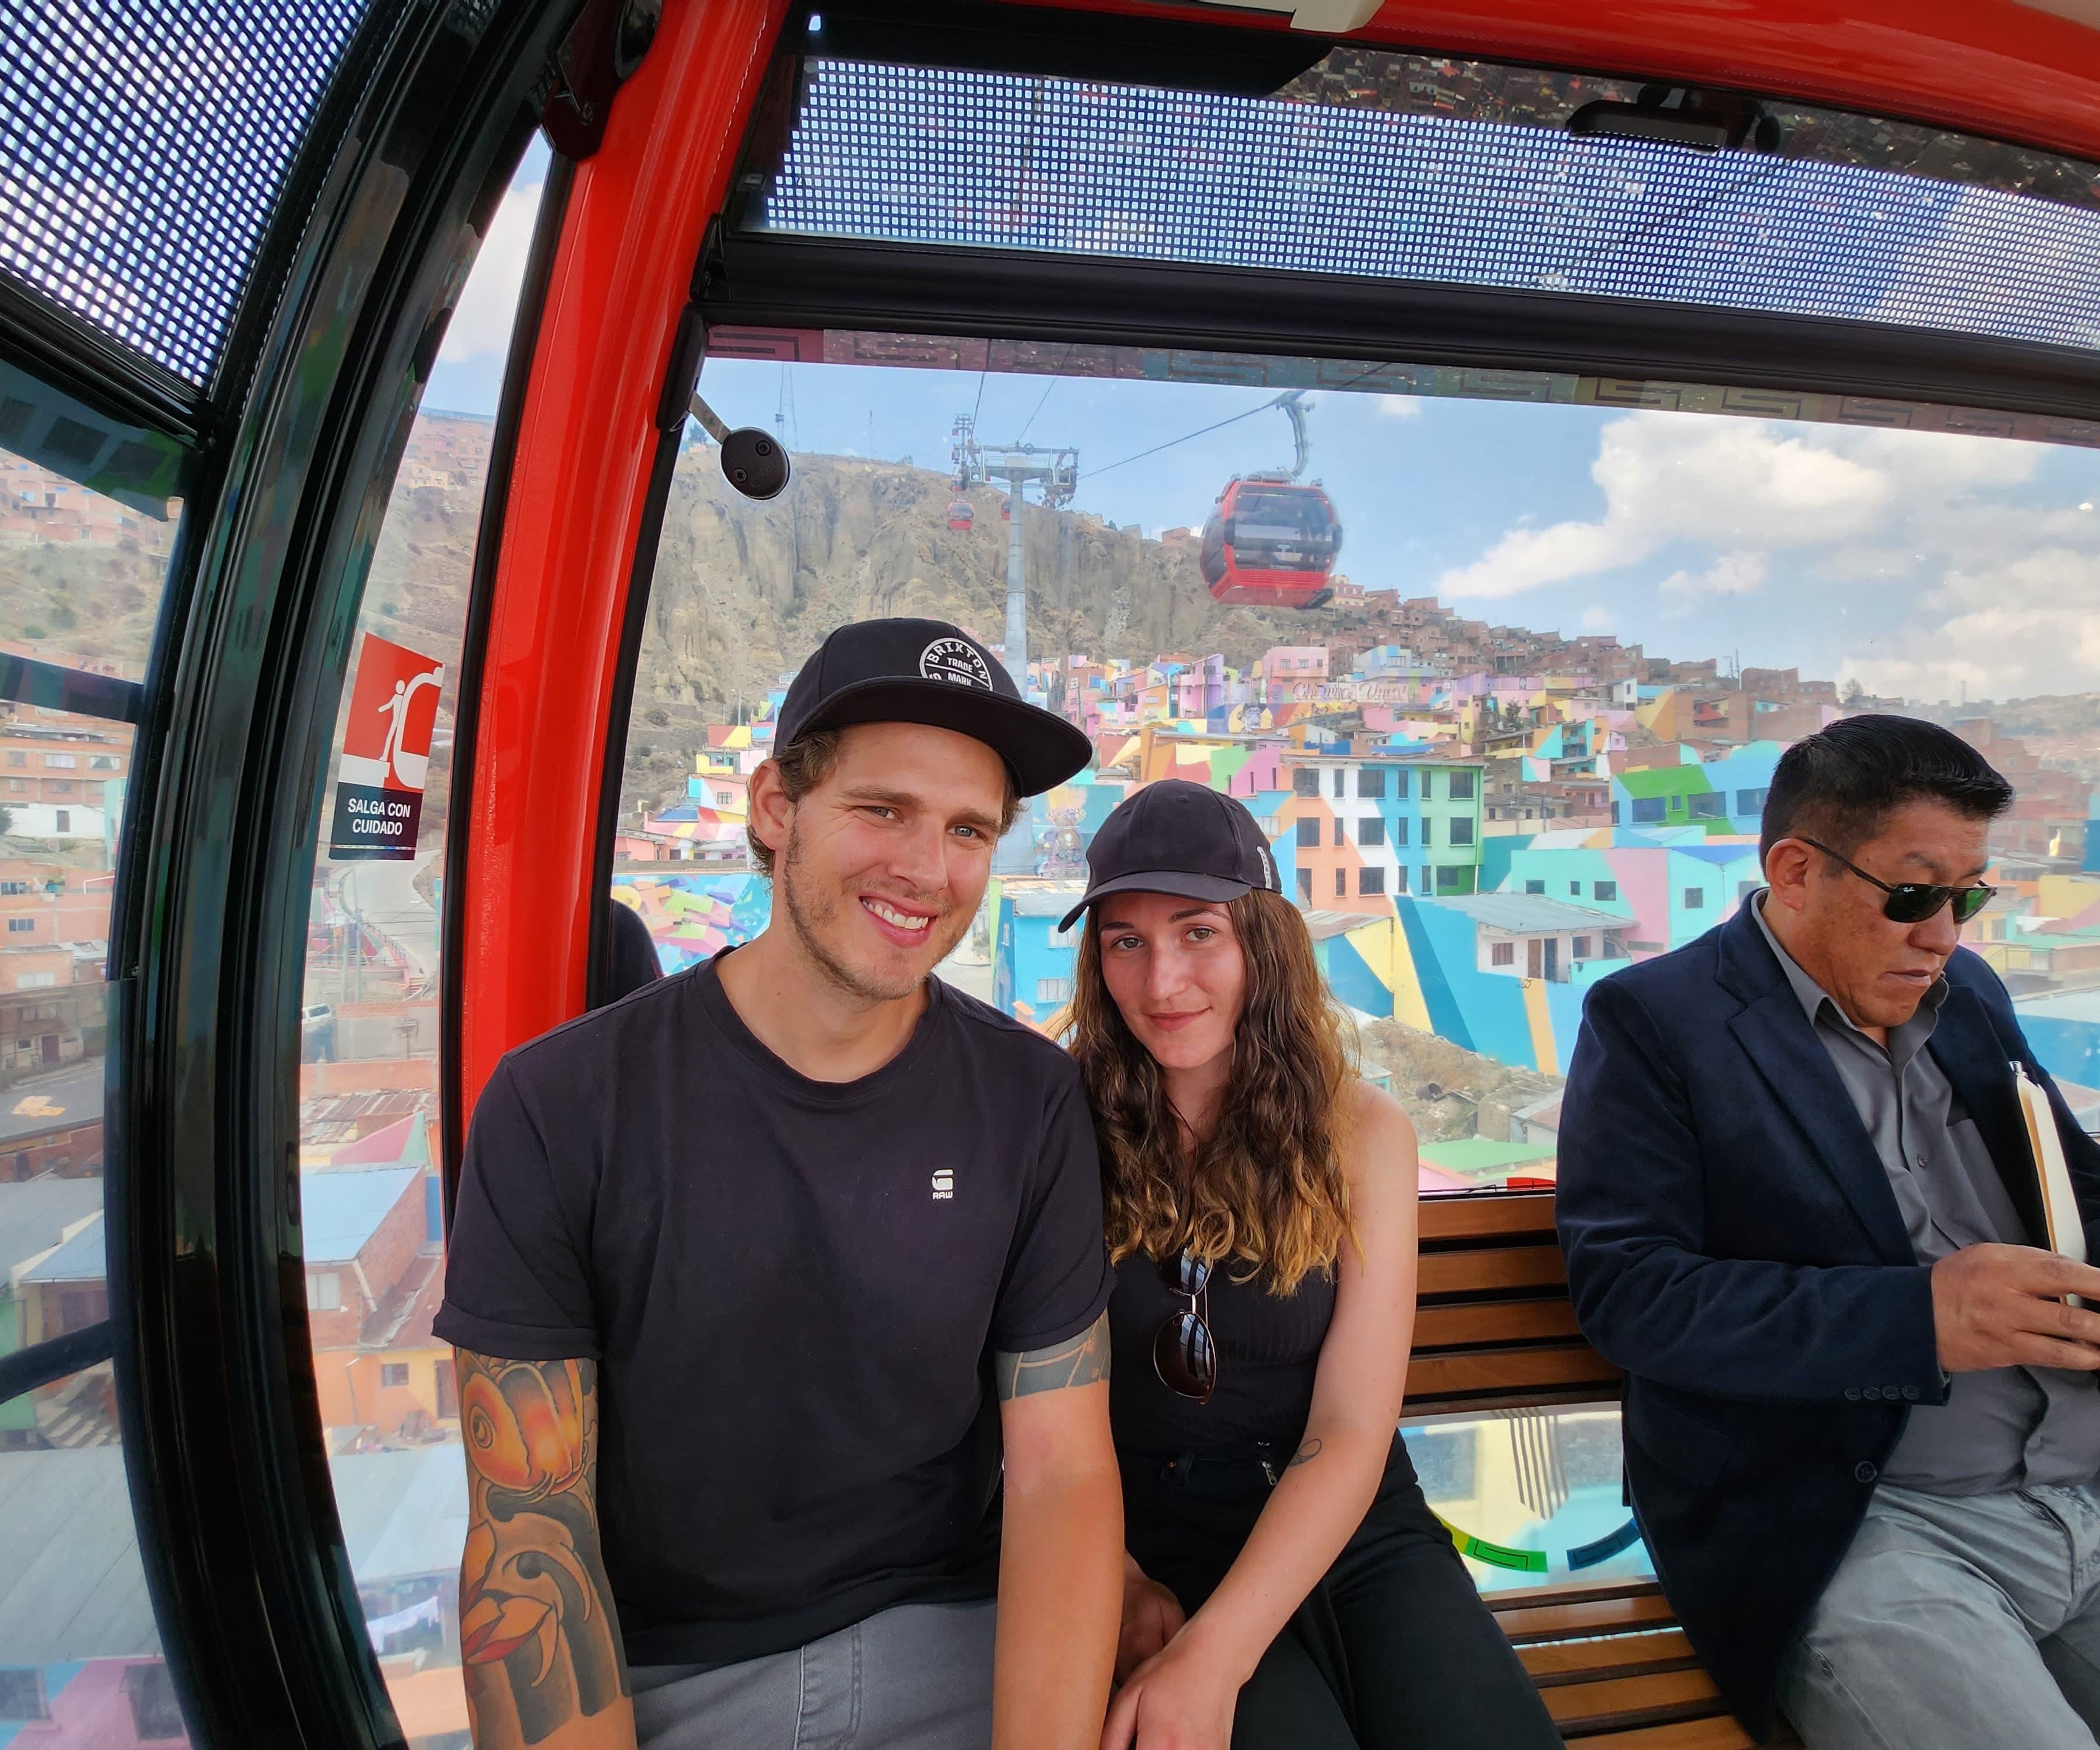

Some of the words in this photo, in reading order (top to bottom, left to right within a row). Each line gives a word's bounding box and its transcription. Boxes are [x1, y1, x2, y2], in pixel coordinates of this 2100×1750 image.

[926, 642, 987, 680] BRIXTON
[947, 657, 973, 673] TRADE
[948, 673, 972, 687] MARK
[348, 798, 385, 815] SALGA
[388, 803, 411, 817] CON
[352, 818, 402, 835] CUIDADO
[932, 1191, 953, 1200] RAW
